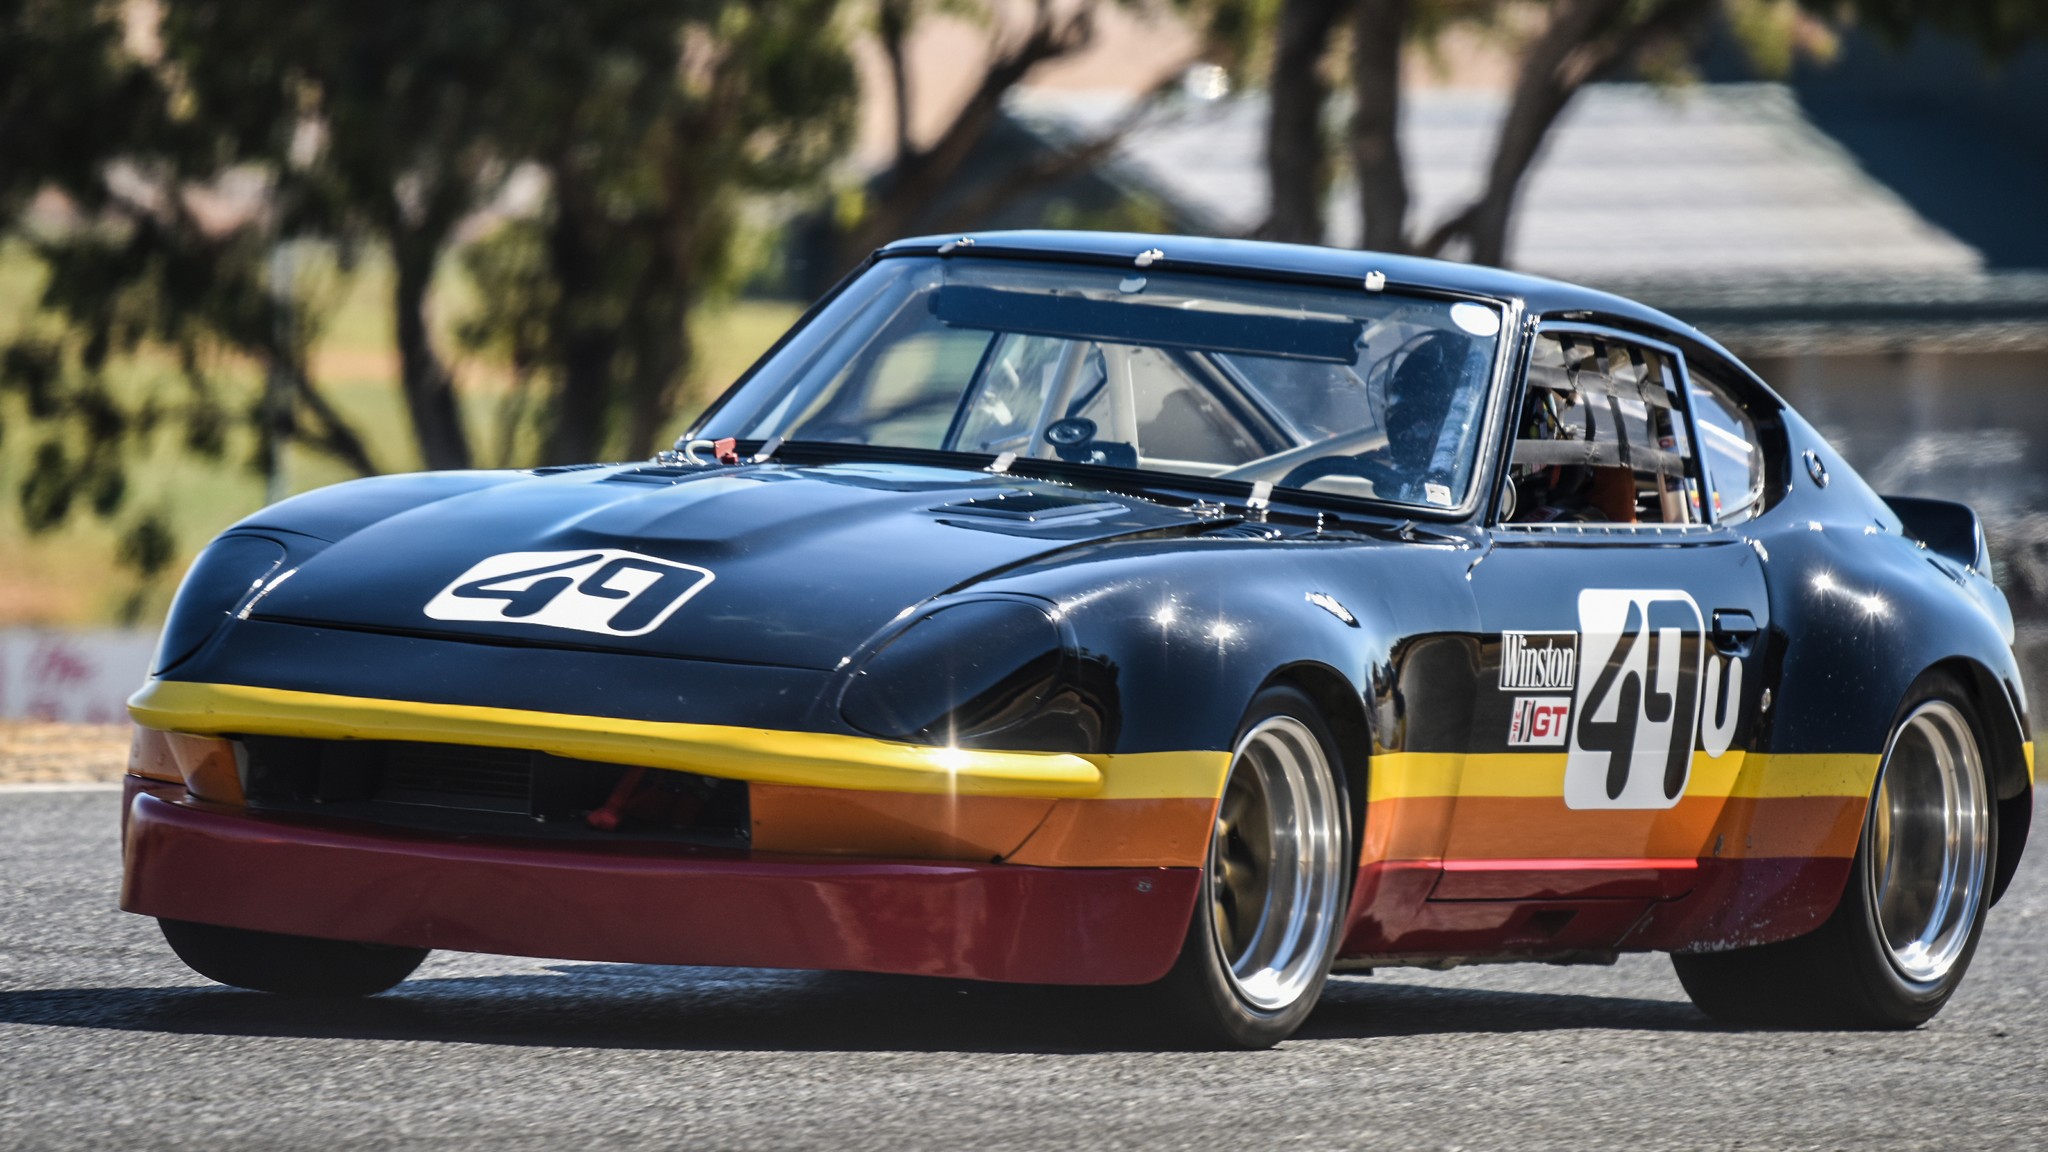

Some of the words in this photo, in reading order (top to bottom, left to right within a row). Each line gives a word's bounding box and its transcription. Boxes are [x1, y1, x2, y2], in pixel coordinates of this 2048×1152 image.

[452, 553, 706, 632] 49
[1504, 634, 1575, 688] Winston
[1532, 705, 1568, 737] GT
[1577, 599, 1701, 801] 49
